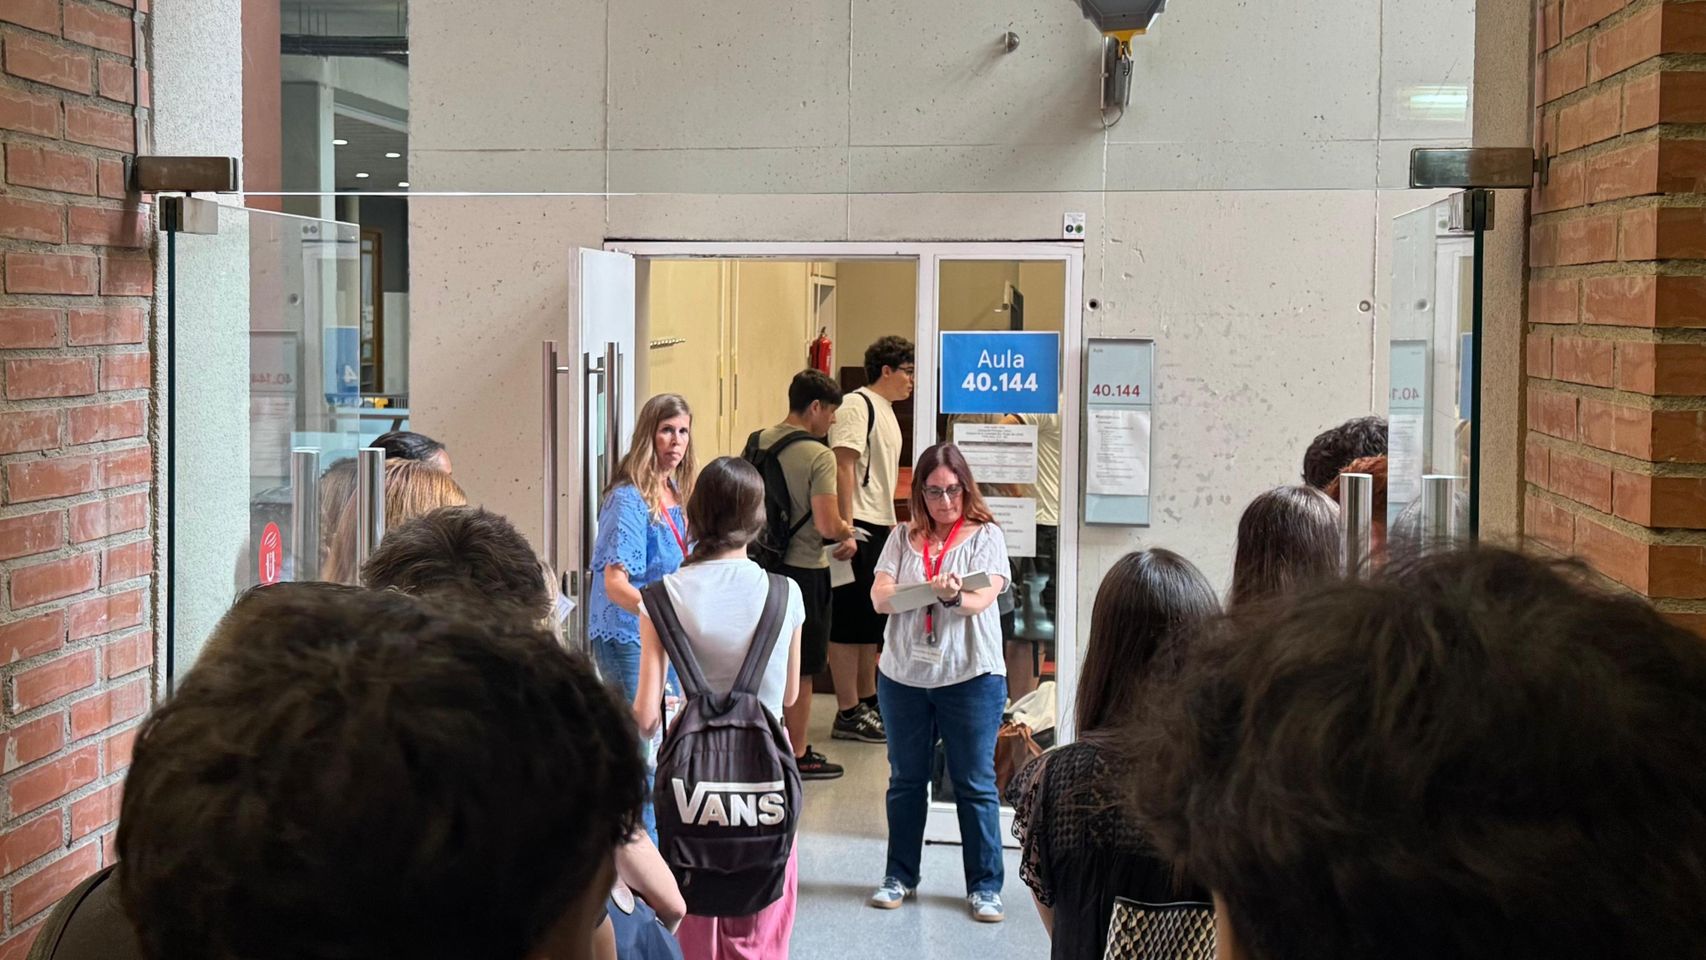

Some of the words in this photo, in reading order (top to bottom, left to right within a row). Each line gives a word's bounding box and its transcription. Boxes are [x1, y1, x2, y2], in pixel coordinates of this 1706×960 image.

[977, 349, 1025, 369] Aula
[961, 372, 1039, 392] 40.144
[1092, 384, 1141, 397] 40.144
[671, 777, 786, 827] VANS
